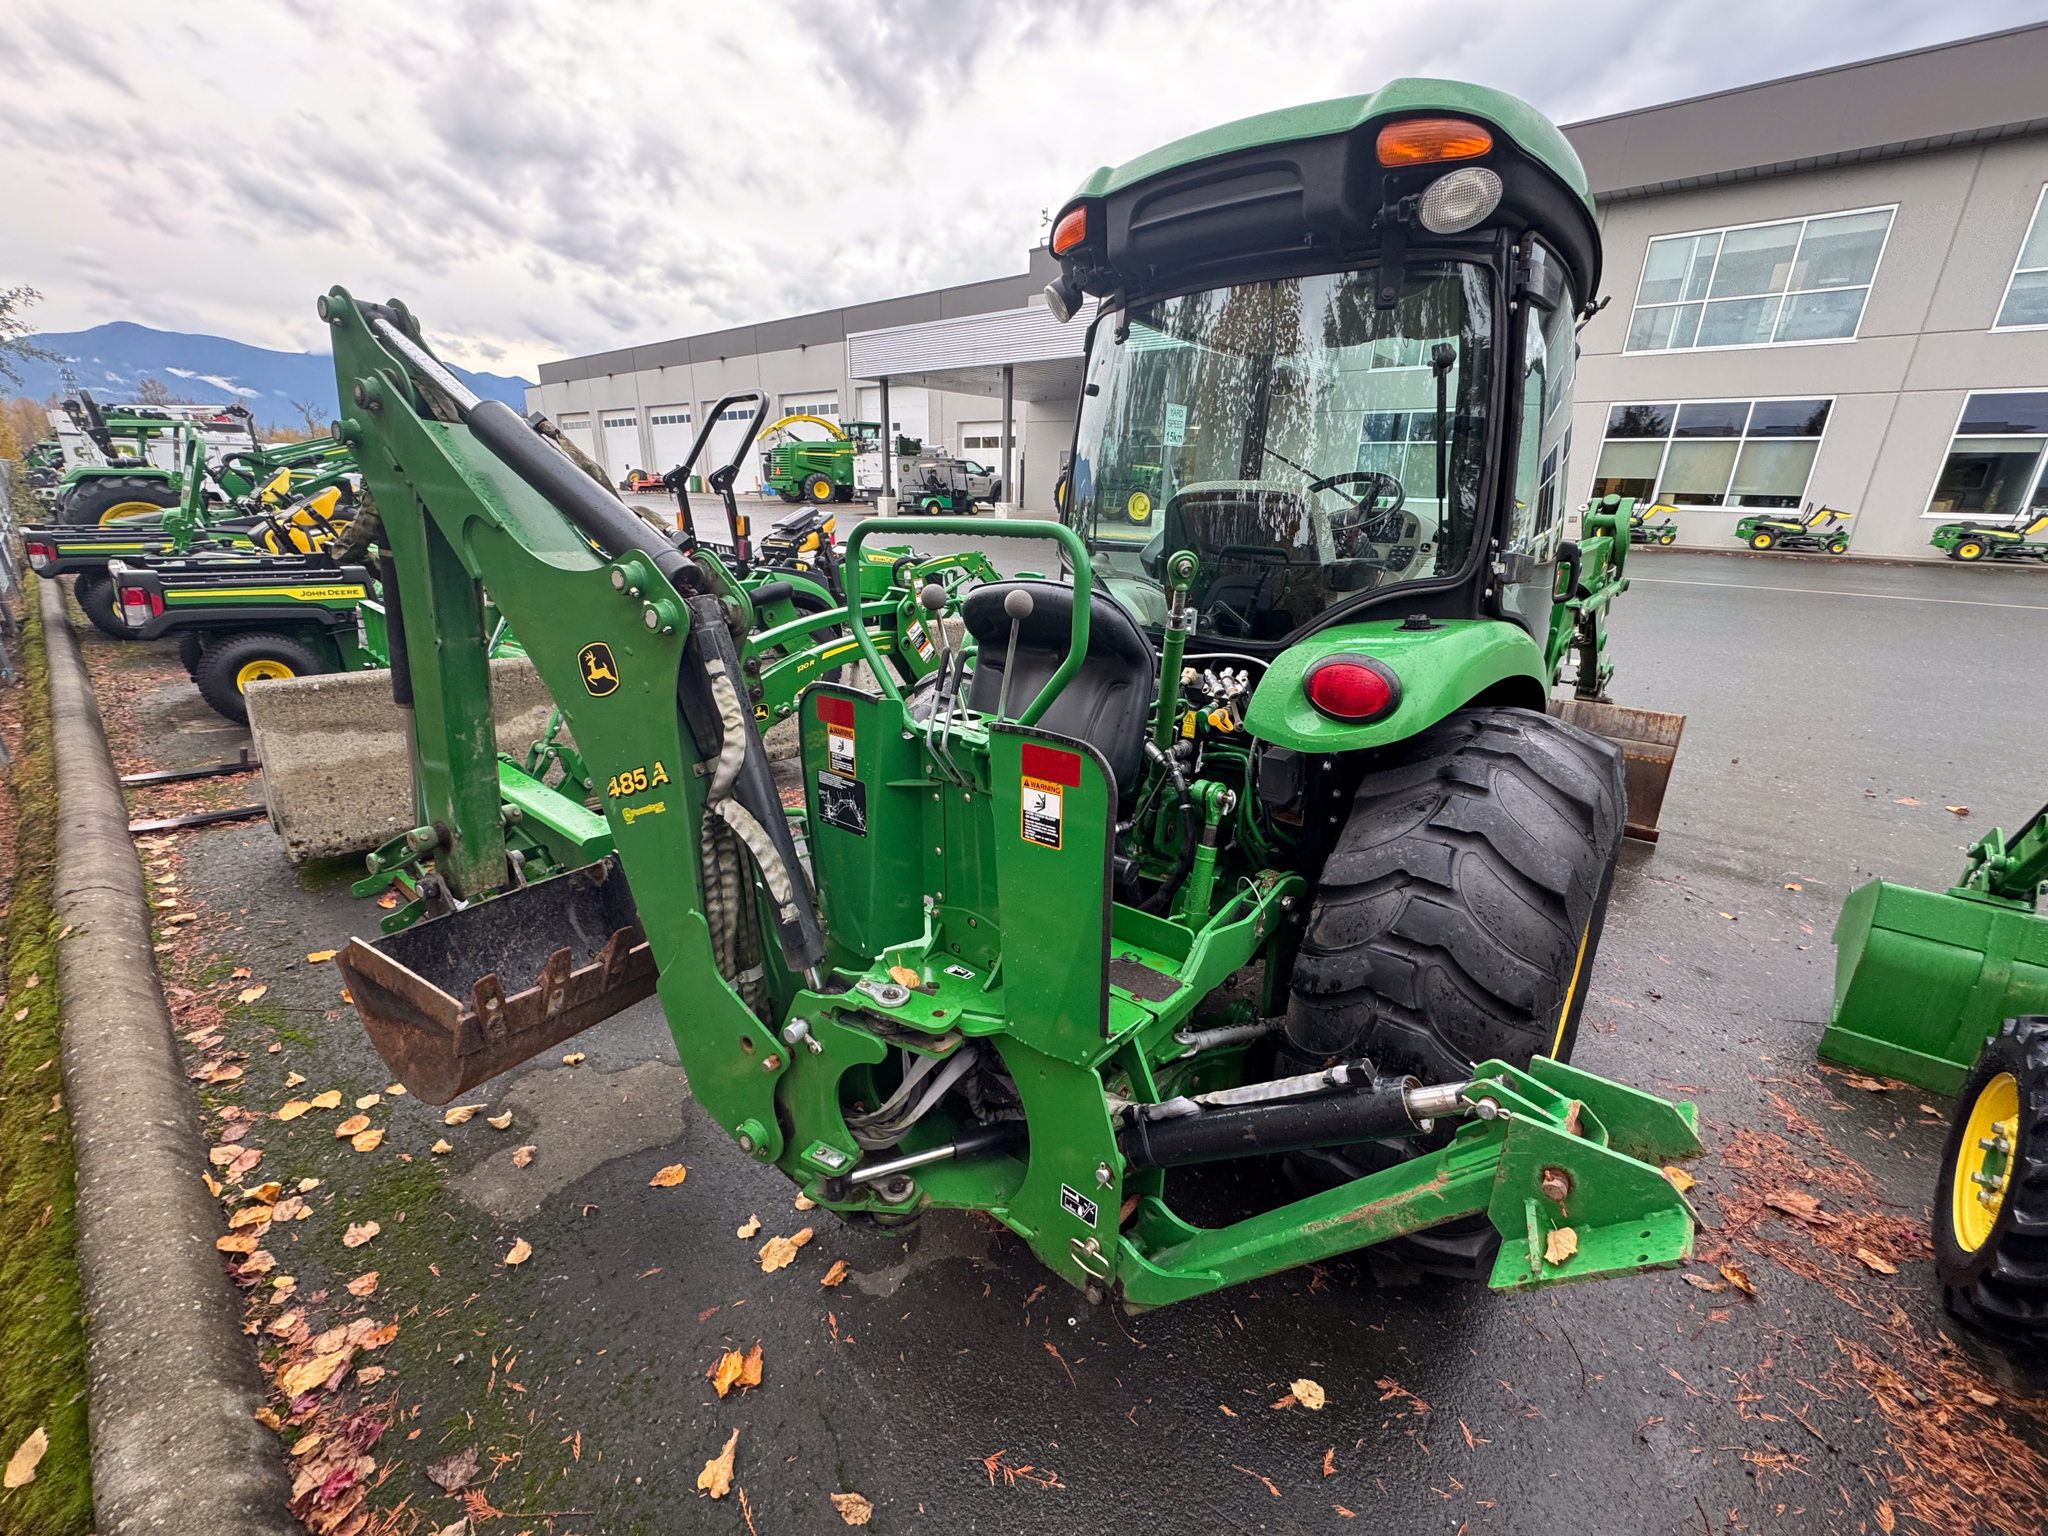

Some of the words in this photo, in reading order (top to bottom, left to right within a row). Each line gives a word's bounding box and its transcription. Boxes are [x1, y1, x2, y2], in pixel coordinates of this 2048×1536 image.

[1170, 409, 1183, 418] YARD
[1167, 419, 1183, 428] SPEED
[1166, 431, 1182, 442] 15km
[833, 726, 854, 738] WARNING
[606, 766, 649, 799] 485
[651, 760, 671, 789] A
[1030, 780, 1060, 794] WARNING
